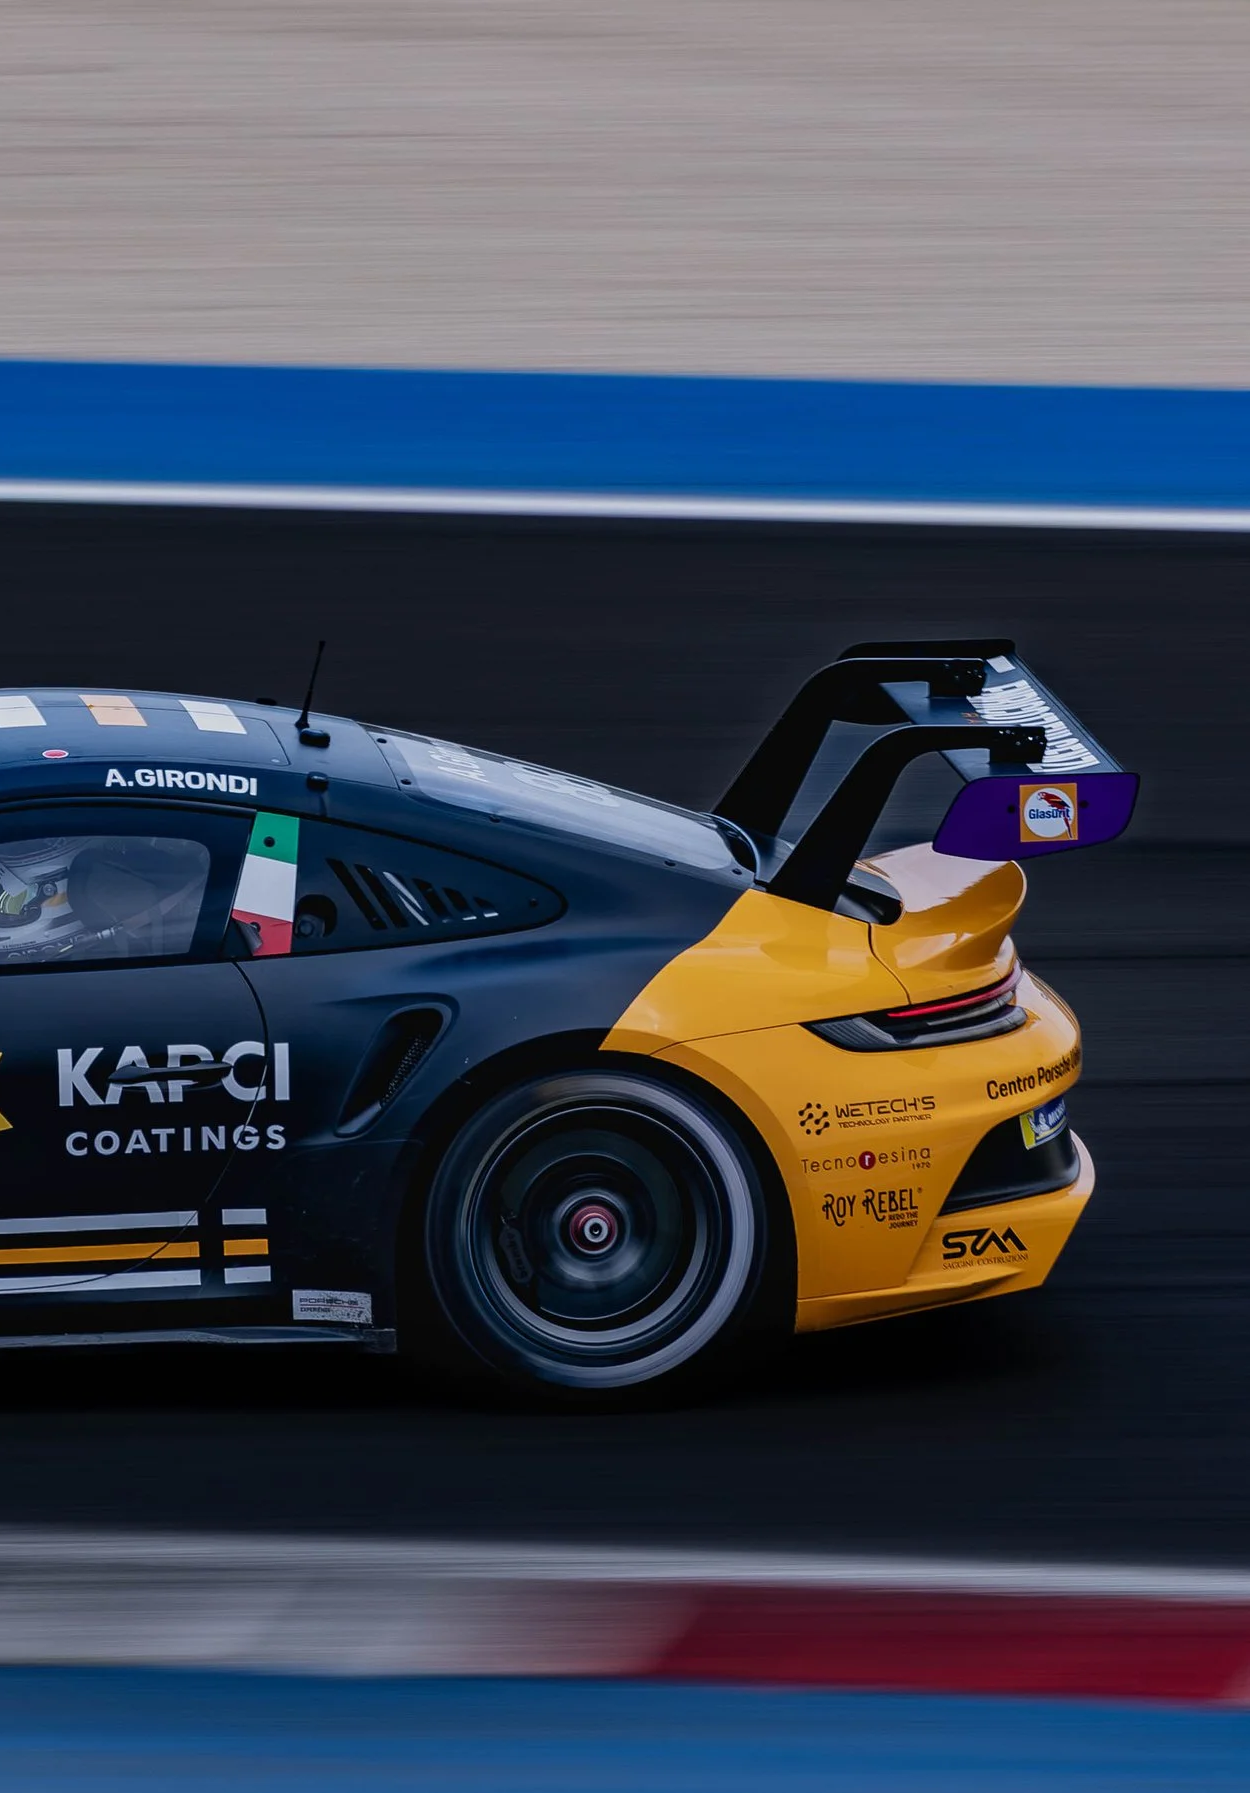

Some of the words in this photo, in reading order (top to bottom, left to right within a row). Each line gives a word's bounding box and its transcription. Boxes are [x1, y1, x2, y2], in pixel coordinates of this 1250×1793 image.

[105, 768, 258, 796] A.GIRONDI
[1028, 808, 1072, 822] Glasurit
[57, 1041, 291, 1108] KAPCI
[986, 1079, 1036, 1101] Centro
[835, 1096, 936, 1119] WETECH'S
[65, 1124, 287, 1157] COATINGS
[822, 1193, 856, 1227] ROY
[862, 1188, 919, 1222] REBEL
